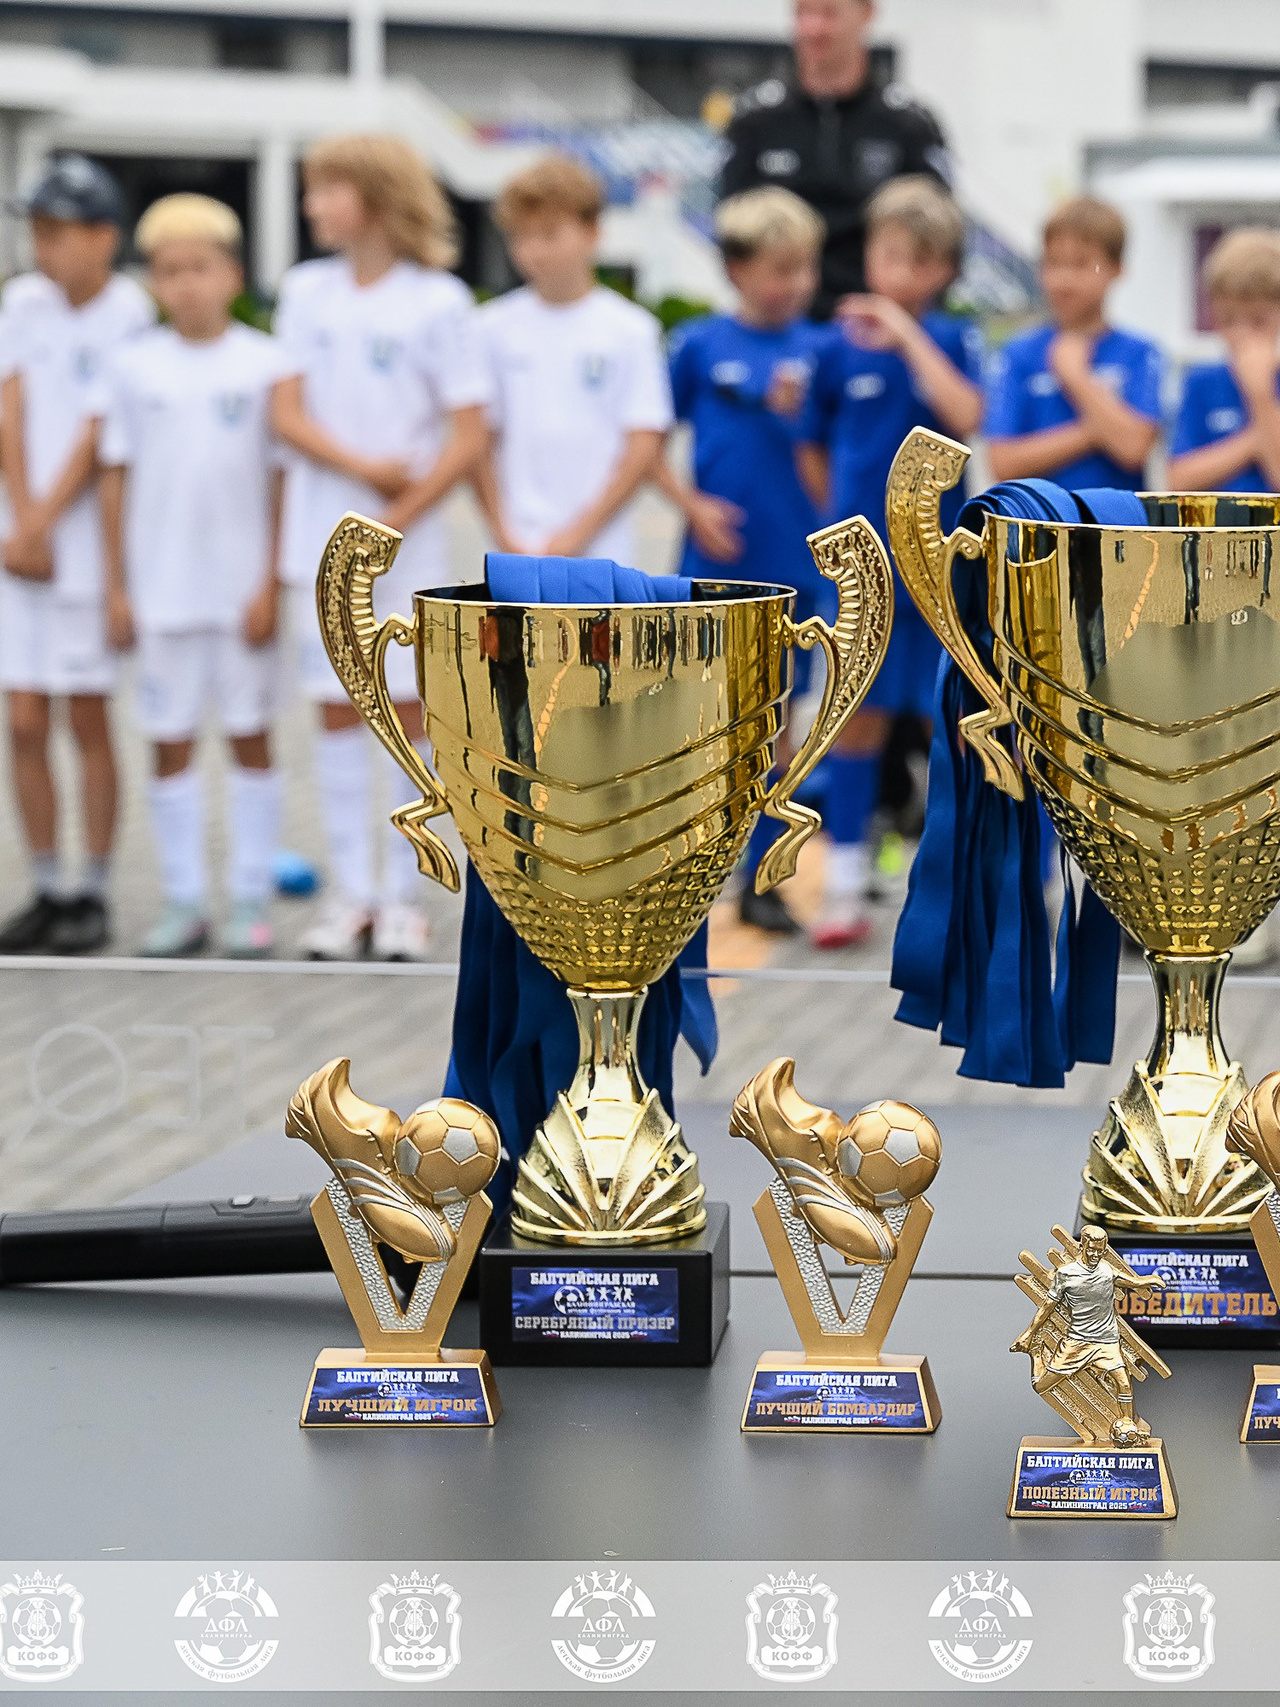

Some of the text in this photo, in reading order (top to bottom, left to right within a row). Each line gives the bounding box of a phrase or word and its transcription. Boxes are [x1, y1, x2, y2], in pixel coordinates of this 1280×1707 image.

[1122, 1252, 1249, 1267] БАЛТИЙСКАЯ ЛИГА
[530, 1271, 659, 1286] БАЛТИЙСКАЯ ЛИГА
[1115, 1292, 1278, 1316] ОБЕДИТЕЛЬ
[515, 1315, 675, 1330] СЕРЕБРЯНЫЙ ПРИЗЕР
[337, 1369, 459, 1383] БАЛТИЙСКАЯ ЛИГА
[776, 1373, 897, 1386] БАЛТИЙСКАЯ ЛИГА
[318, 1397, 477, 1412] ЛУЧШИЙ ИГРОК
[756, 1401, 916, 1416] ЛУЧШИЙ БОМБАРДИР
[1027, 1454, 1154, 1470] БАЛТИЙСКАЯ ЛИГА
[1022, 1485, 1158, 1500] ПОЛЕЗНЫЙ ИГРОК
[1051, 1501, 1128, 1510] КАЛИНИНГРАД 2025
